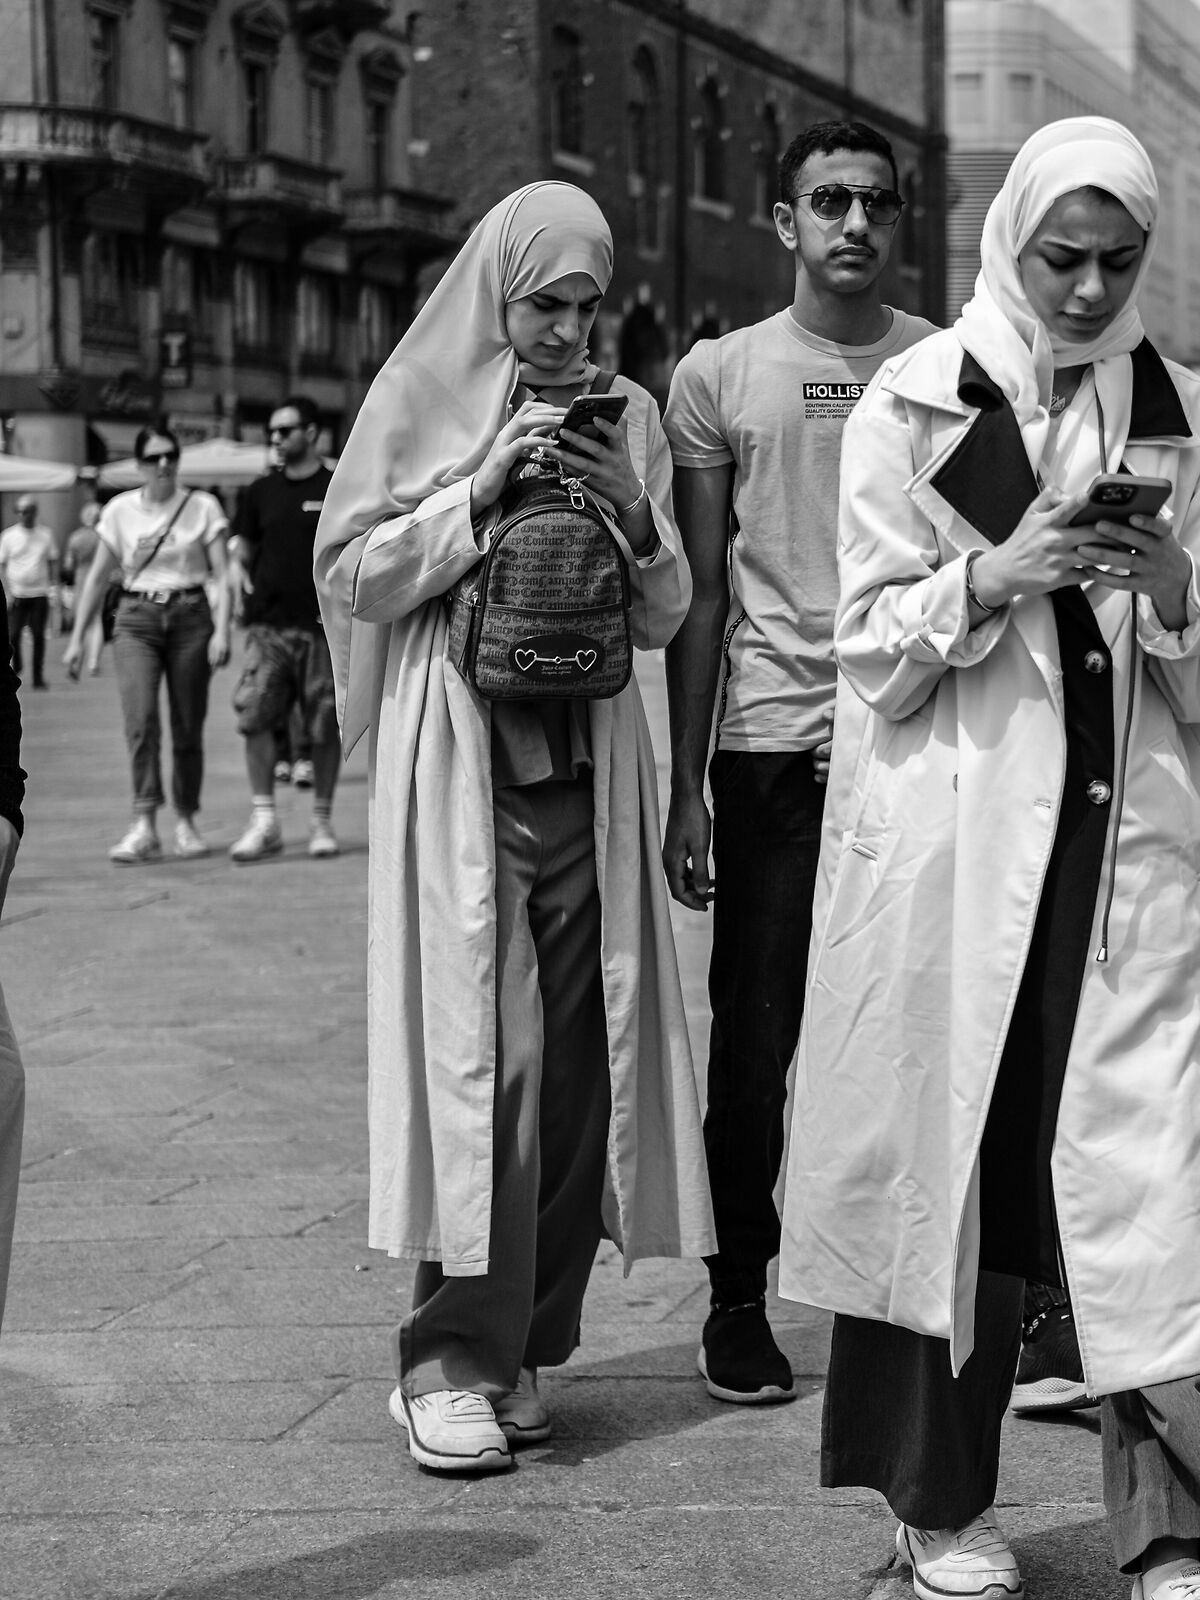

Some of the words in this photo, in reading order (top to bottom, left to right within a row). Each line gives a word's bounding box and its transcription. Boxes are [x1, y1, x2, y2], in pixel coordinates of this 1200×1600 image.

[523, 535, 565, 546] Couture
[567, 536, 595, 547] Juicy
[522, 562, 564, 572] Couture
[521, 587, 563, 598] Couture
[564, 586, 591, 598] Juicy
[485, 621, 513, 635] Juicy
[584, 623, 621, 635] Couture
[482, 674, 509, 685] Juicy
